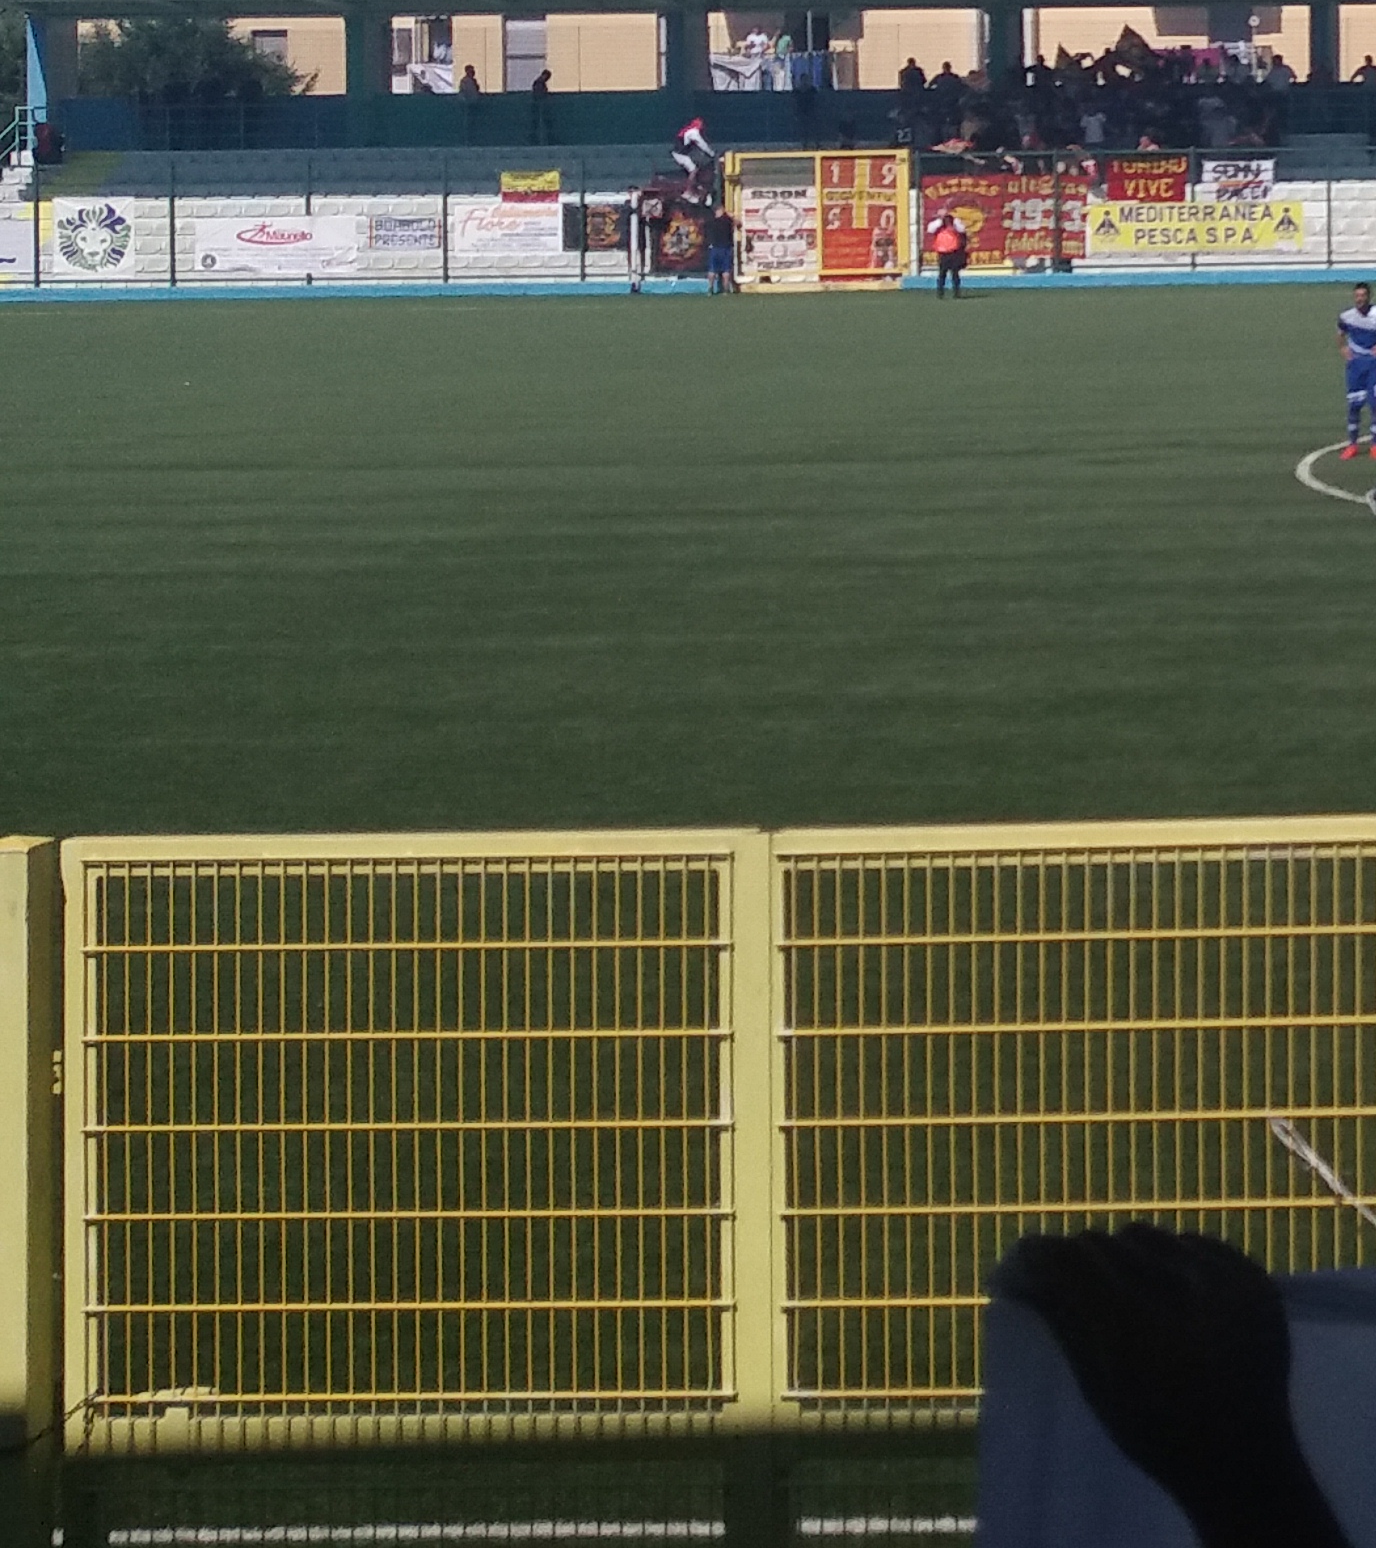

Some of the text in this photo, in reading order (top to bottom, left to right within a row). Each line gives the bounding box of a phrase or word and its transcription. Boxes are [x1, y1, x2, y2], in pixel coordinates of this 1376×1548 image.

[1124, 178, 1175, 199] VIVE
[1119, 204, 1274, 223] MEDITERRANEA
[1134, 228, 1199, 245] PESCA
